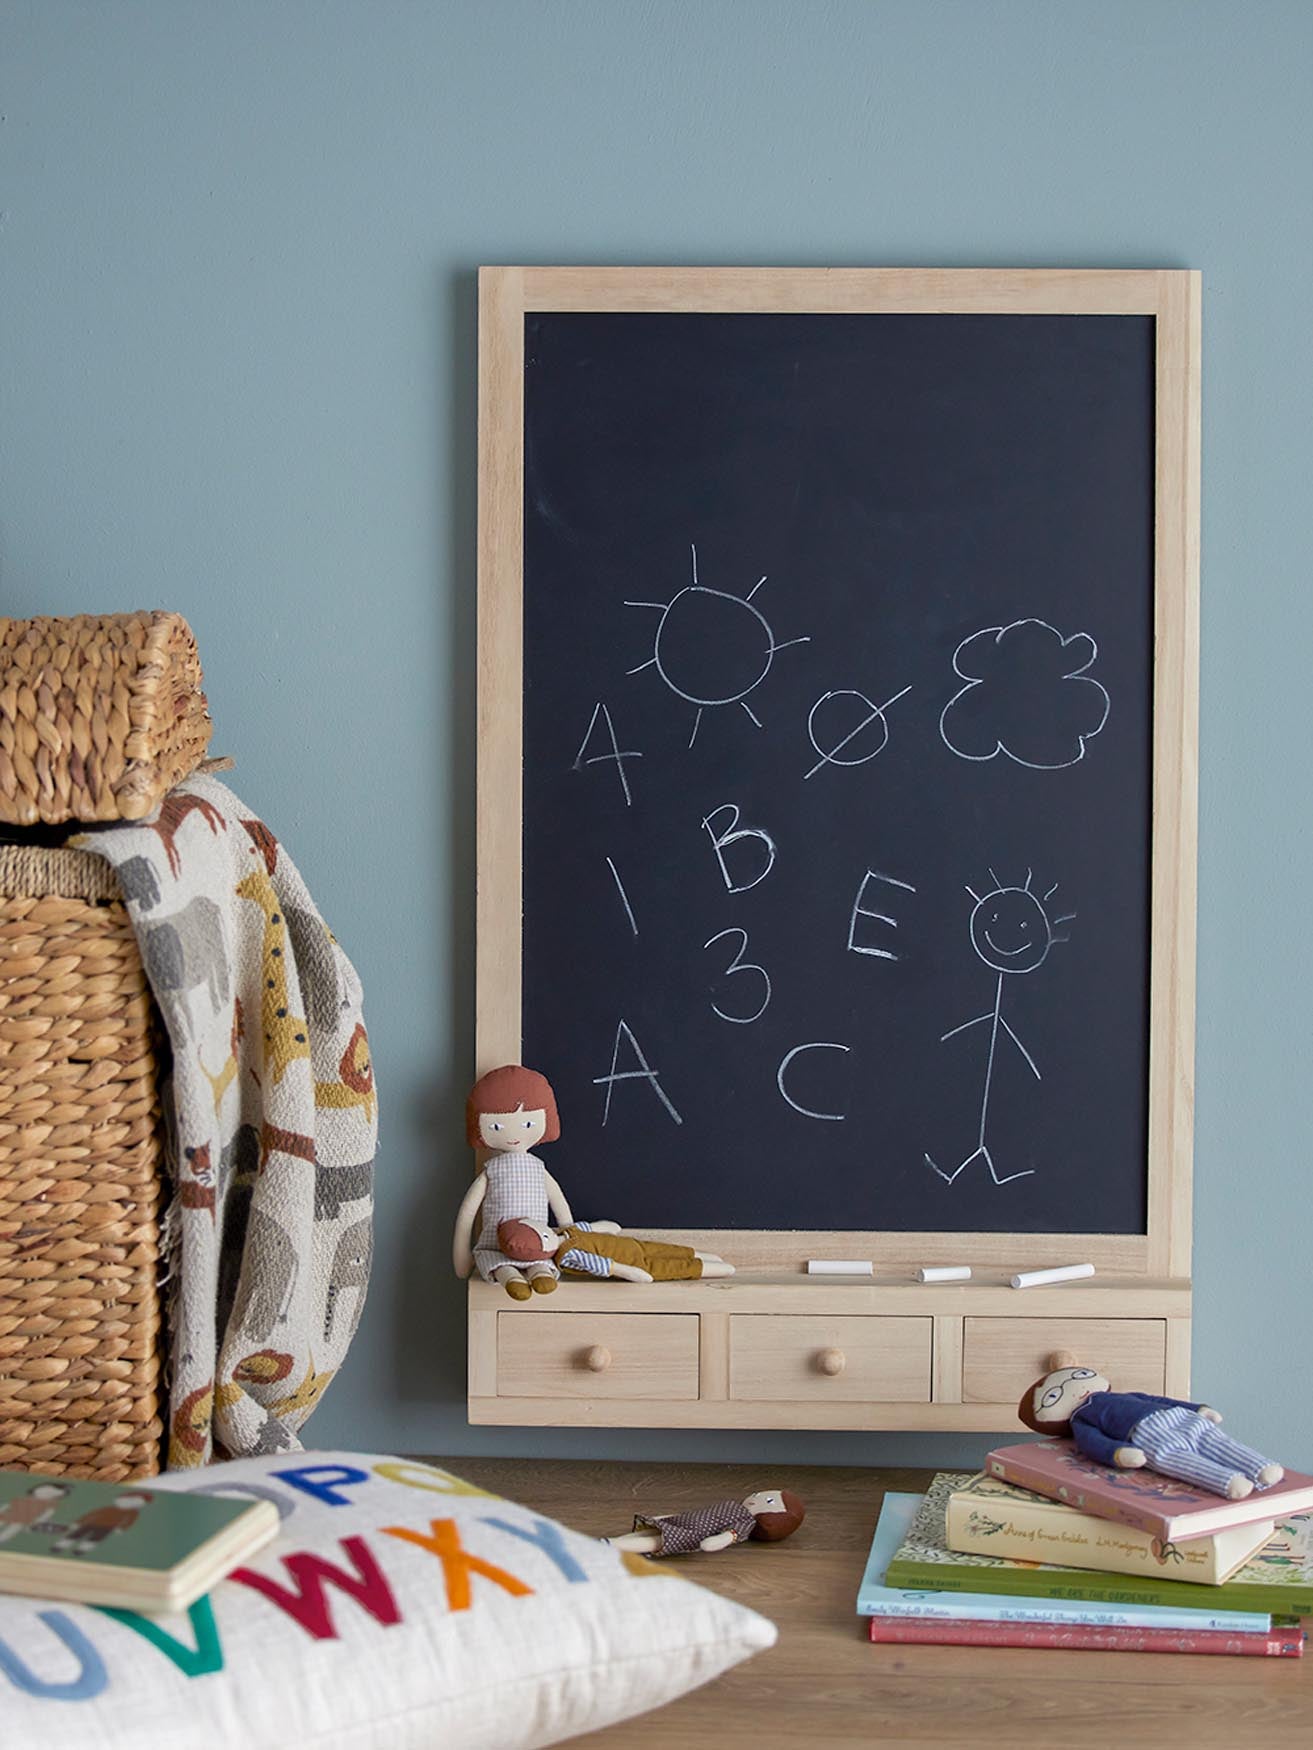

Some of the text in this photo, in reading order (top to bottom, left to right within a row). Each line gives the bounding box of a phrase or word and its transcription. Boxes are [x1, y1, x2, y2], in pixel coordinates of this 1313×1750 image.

[701, 804, 776, 894] B
[848, 870, 917, 961] E
[703, 928, 772, 1024] 3
[593, 1020, 683, 1126] A
[777, 1043, 851, 1121] C
